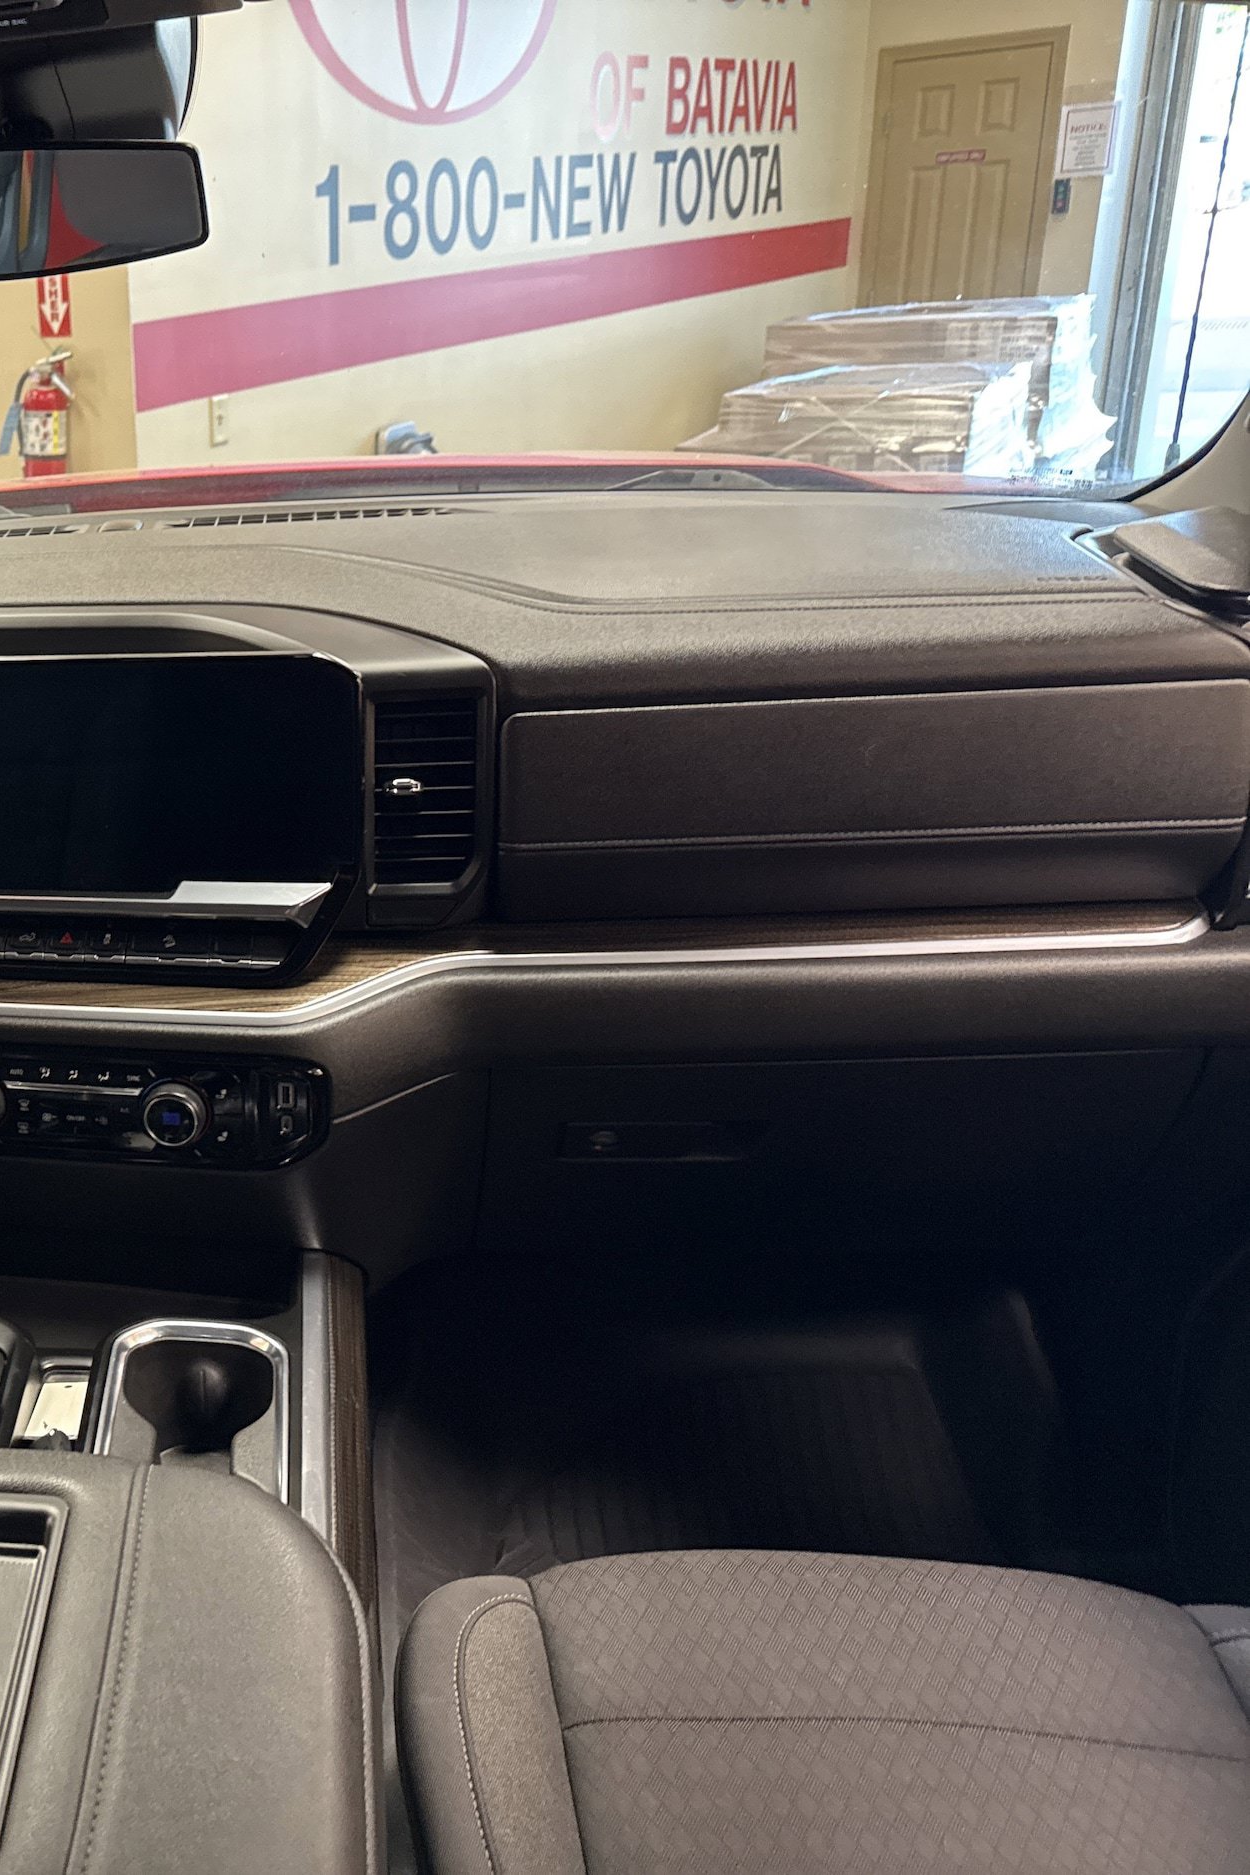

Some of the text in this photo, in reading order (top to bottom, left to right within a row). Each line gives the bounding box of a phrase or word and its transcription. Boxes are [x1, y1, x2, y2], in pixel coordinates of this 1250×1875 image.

[590, 51, 798, 139] OF BATAVIA
[315, 143, 782, 267] 1-800-NEW TOYOTA
